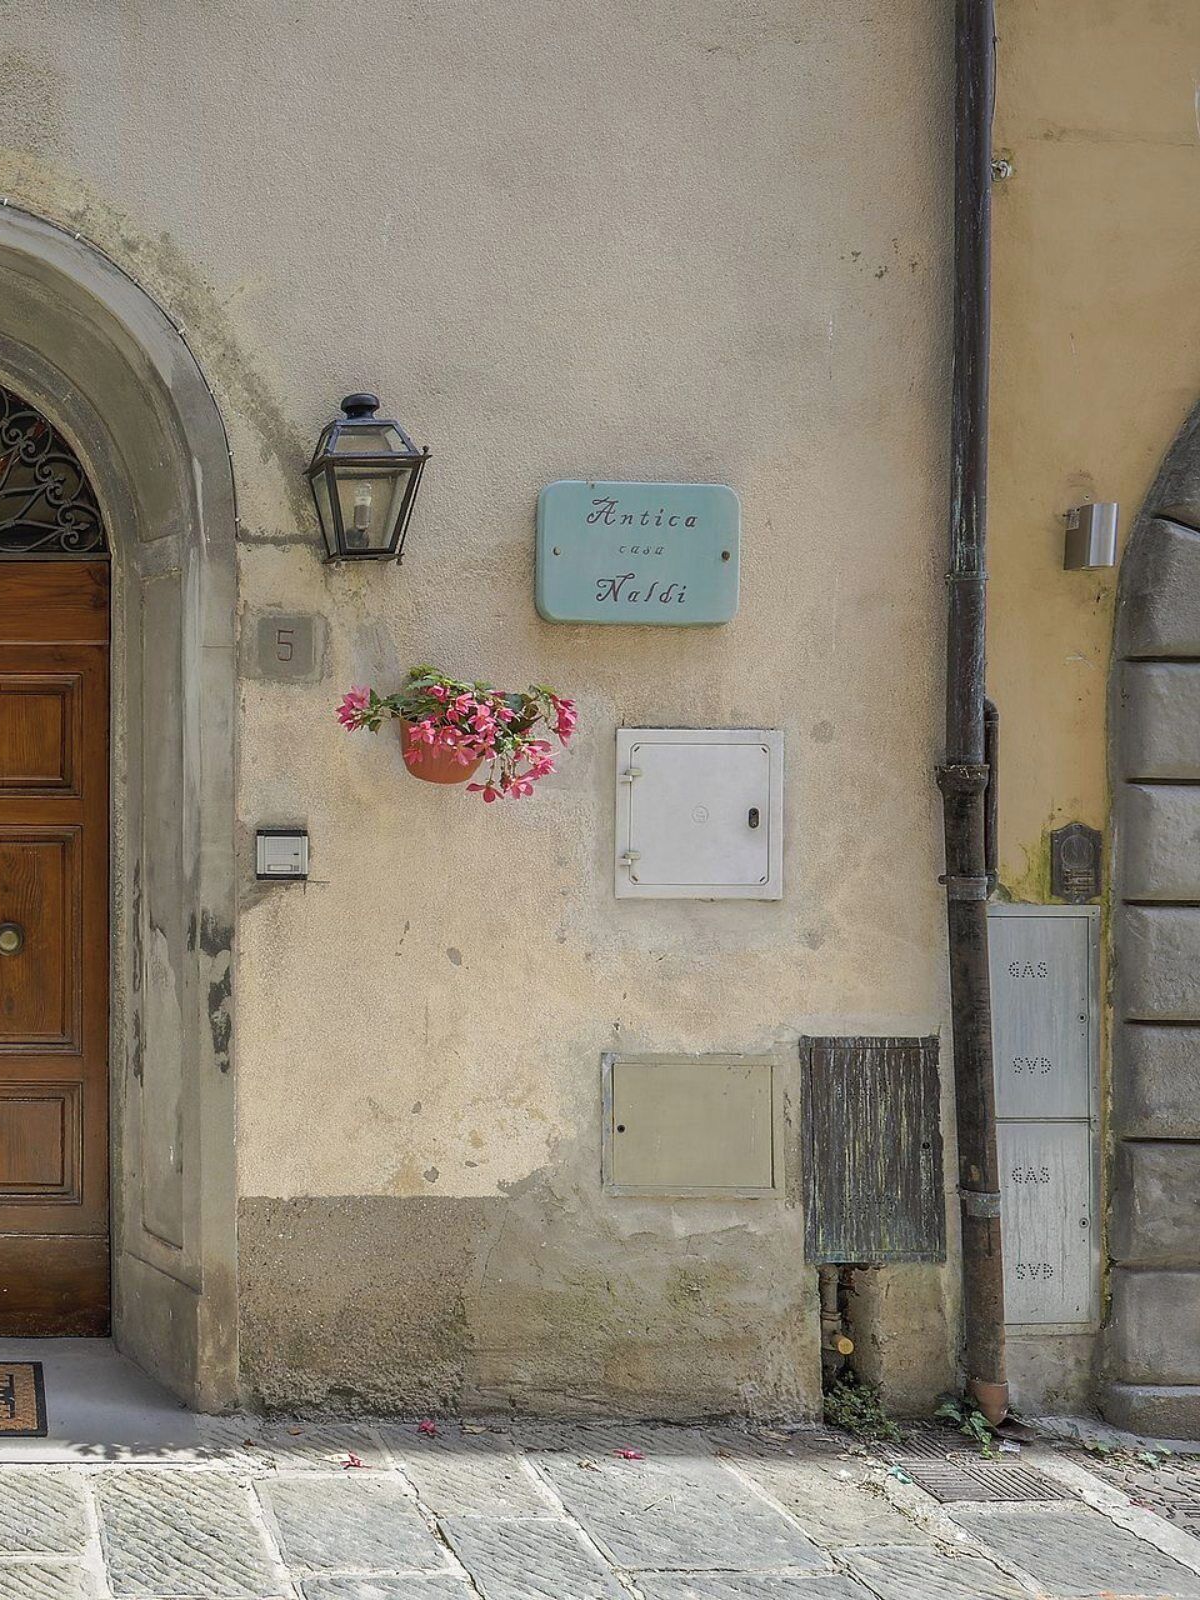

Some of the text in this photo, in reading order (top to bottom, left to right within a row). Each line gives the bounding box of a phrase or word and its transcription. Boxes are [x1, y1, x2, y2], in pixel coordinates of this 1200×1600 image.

[586, 496, 698, 528] Antica
[619, 544, 665, 556] casa
[596, 572, 687, 604] Naldi
[277, 629, 294, 662] 5
[1008, 961, 1048, 978] GAS
[1011, 1166, 1051, 1184] GAS
